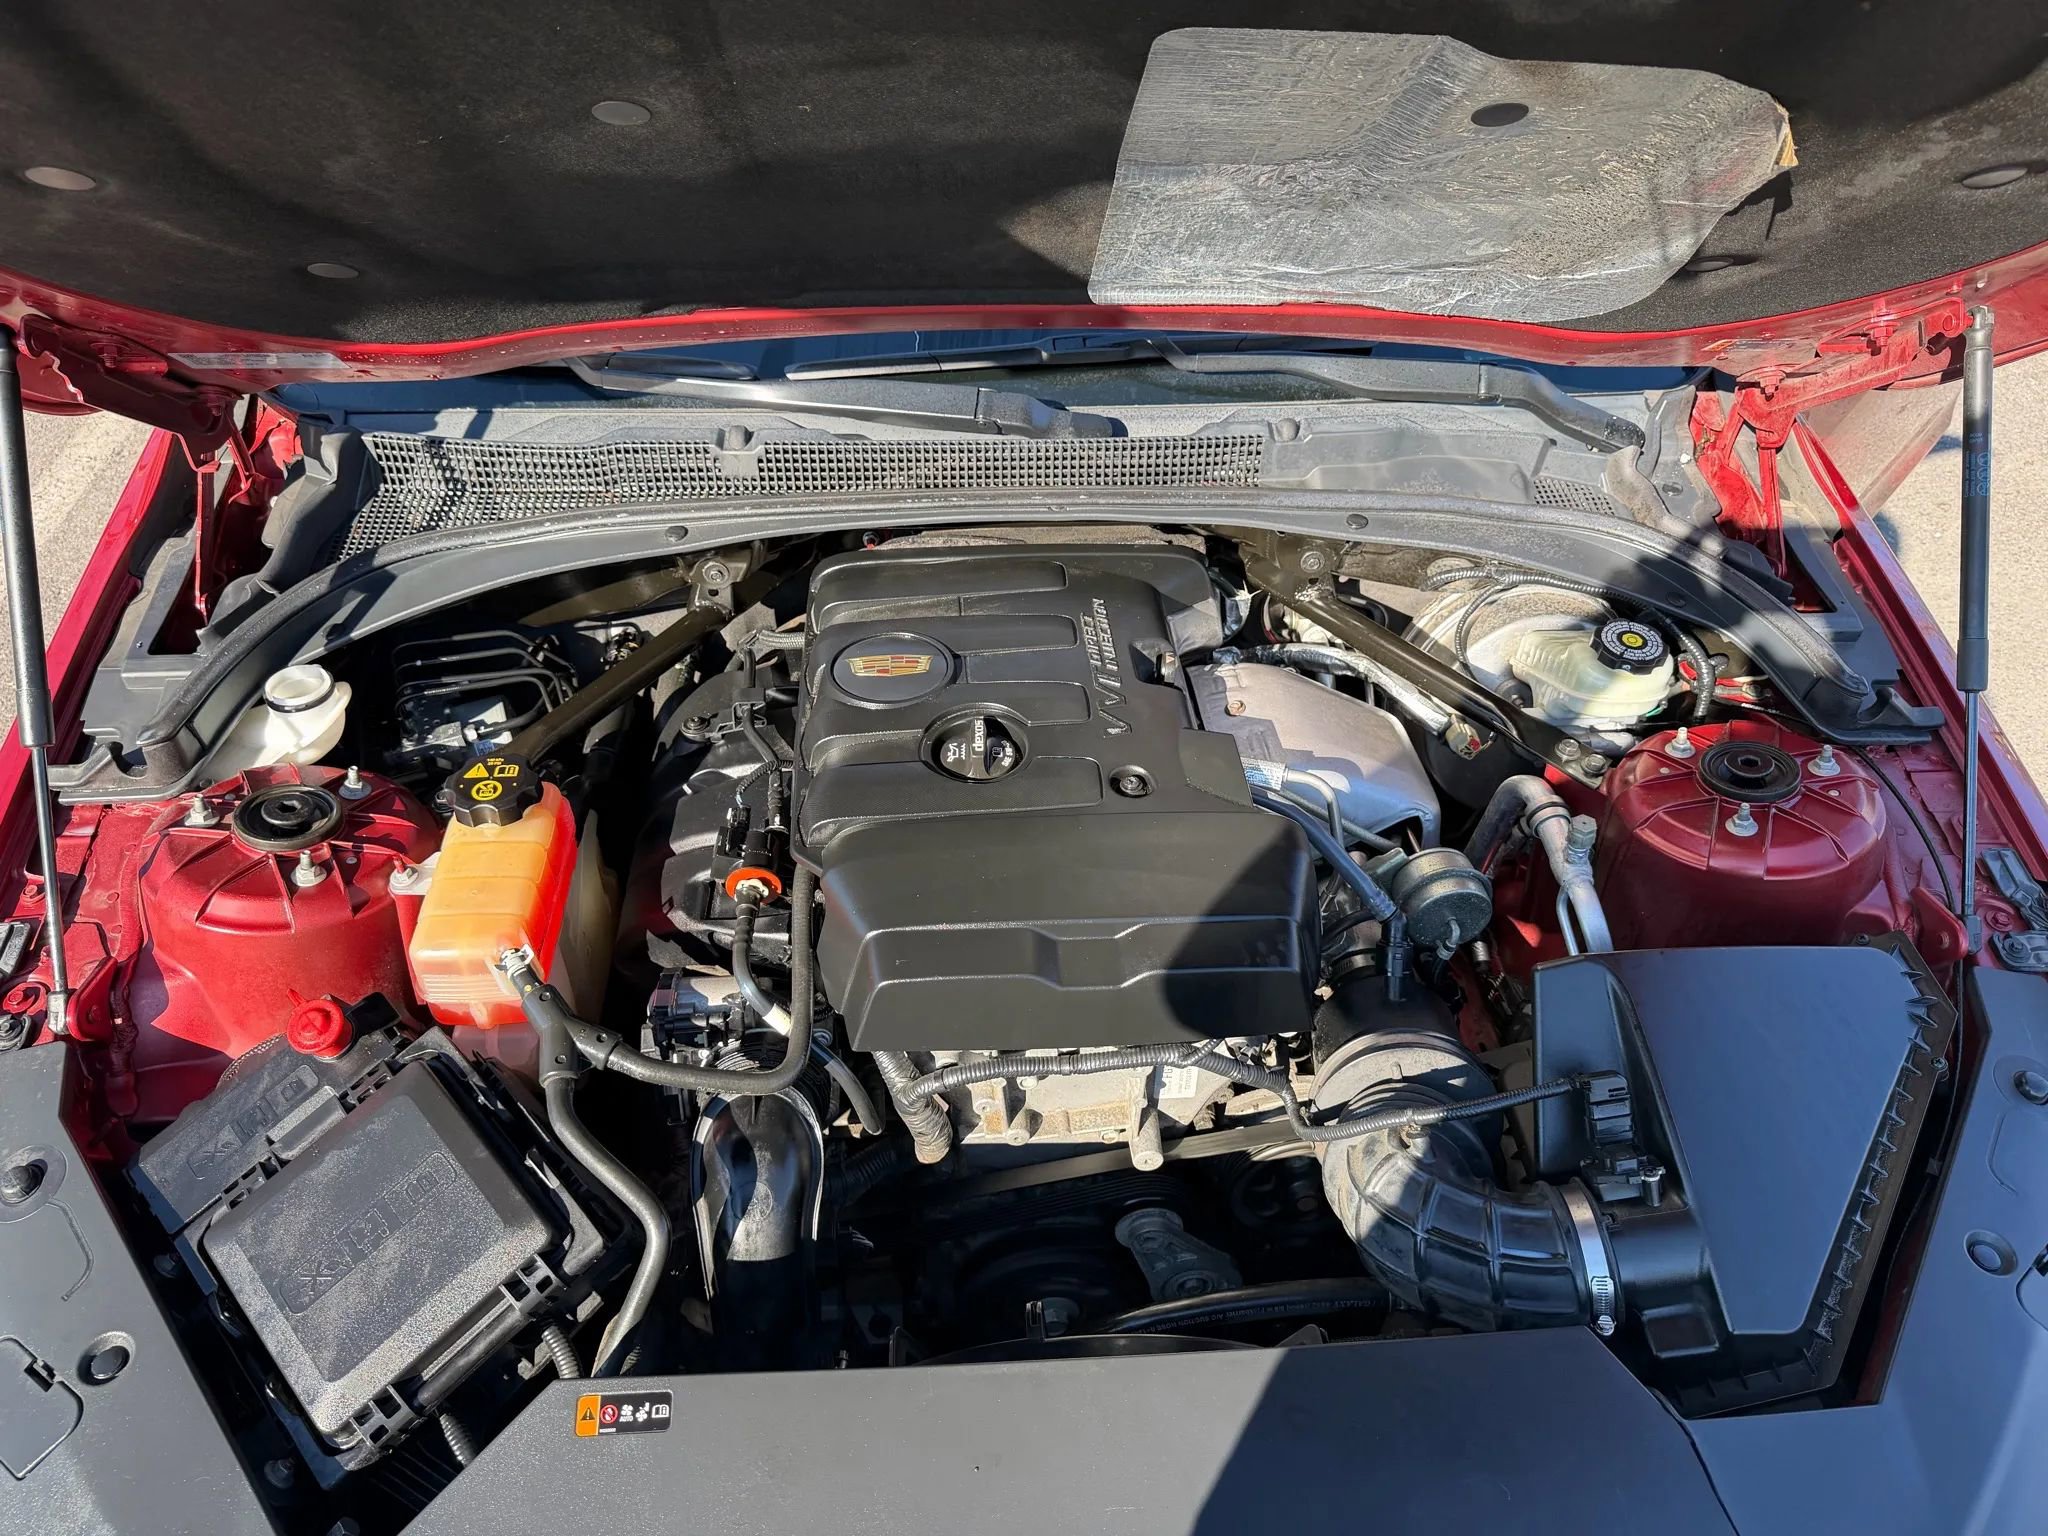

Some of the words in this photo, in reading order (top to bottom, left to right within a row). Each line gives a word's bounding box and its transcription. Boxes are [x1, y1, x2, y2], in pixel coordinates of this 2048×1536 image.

[1081, 612, 1102, 666] DIRECT
[1092, 598, 1119, 672] INJECTION
[972, 719, 984, 752] dexos
